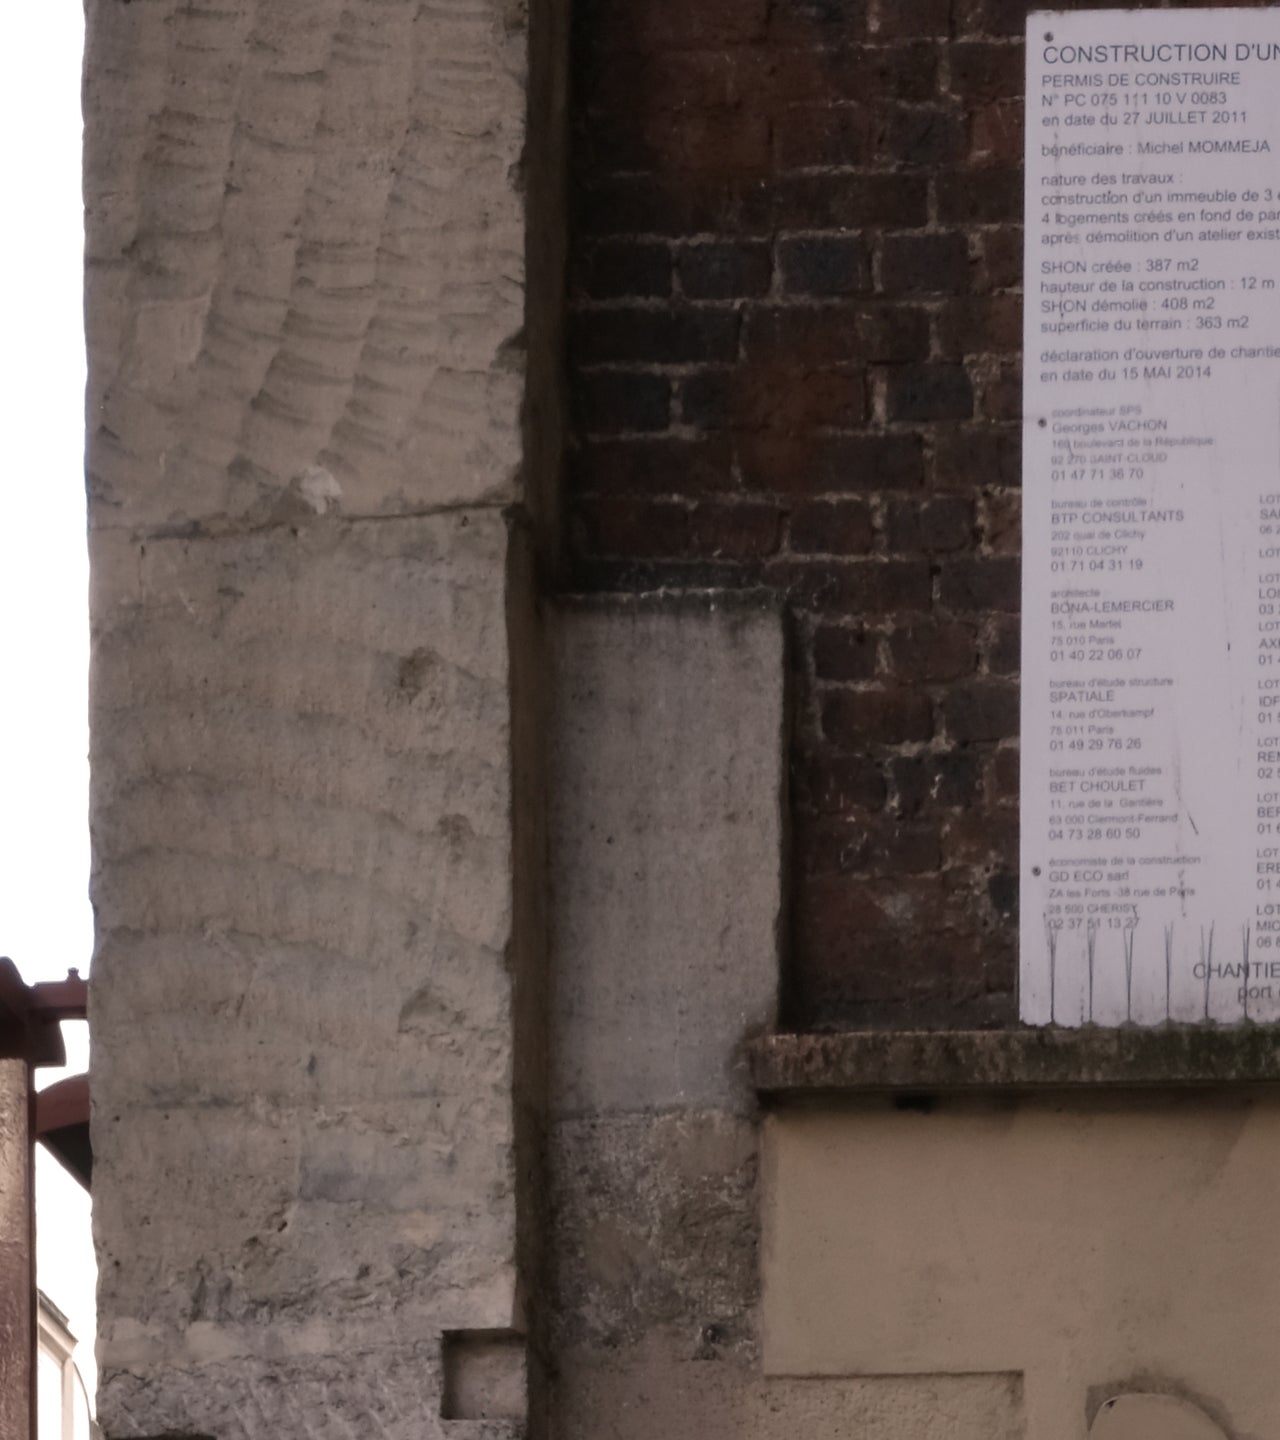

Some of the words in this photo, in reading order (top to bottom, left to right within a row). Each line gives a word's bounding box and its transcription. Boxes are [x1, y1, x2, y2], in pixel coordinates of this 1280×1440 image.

[1043, 44, 1227, 63] CONSTRUCTION
[1042, 74, 1103, 87] PERMIS
[1108, 73, 1130, 87] DE
[1135, 72, 1240, 86] CONSTRUIRE
[1064, 93, 1086, 107] PC
[1090, 93, 1118, 106] 075
[1124, 93, 1147, 106] 111
[1156, 92, 1171, 105] 10
[1176, 92, 1187, 104] V
[1191, 91, 1227, 105] 0083
[1042, 116, 1060, 127] en
[1064, 115, 1095, 126] date
[1100, 113, 1118, 126] du
[1123, 111, 1140, 125] 27
[1145, 111, 1206, 124] JUILLET
[1212, 110, 1246, 124] 2011
[1137, 142, 1183, 154] Michel
[1188, 140, 1270, 153] MOMMEJA
[1041, 175, 1087, 186] nature
[1091, 174, 1117, 185] des
[1041, 193, 1128, 205] construction
[1133, 191, 1162, 204] d'un
[1167, 192, 1237, 202] immeuble
[1241, 190, 1259, 202] de
[1264, 188, 1273, 202] 3
[1042, 213, 1050, 224] 4
[1055, 213, 1129, 225] logements
[1134, 212, 1173, 223] créés
[1177, 212, 1195, 222] en
[1200, 209, 1231, 222] fond
[1236, 210, 1254, 221] de
[1086, 231, 1159, 243] démolition
[1164, 230, 1194, 242] d'un
[1198, 230, 1242, 241] atelier
[1041, 261, 1087, 274] SHON
[1092, 262, 1132, 273] créée
[1146, 258, 1172, 272] 387
[1177, 258, 1199, 271] m2
[1040, 282, 1095, 293] hauteur
[1099, 281, 1117, 292] de
[1122, 280, 1134, 292] la
[1139, 280, 1226, 291] construction
[1241, 276, 1257, 290] 12
[1261, 279, 1275, 289] m
[1041, 299, 1087, 313] SHON
[1091, 299, 1148, 312] démolie
[1161, 297, 1188, 310] 408
[1193, 297, 1215, 310] m2
[1041, 320, 1109, 334] superficie
[1113, 320, 1132, 331] du
[1196, 316, 1222, 329] 363
[1227, 316, 1249, 329] m2
[1040, 350, 1119, 362] déclaration
[1123, 349, 1203, 360] d'ouverture
[1208, 348, 1226, 359] de
[1040, 371, 1058, 382] en
[1062, 370, 1094, 382] date
[1098, 369, 1116, 381] du
[1123, 366, 1138, 380] 15
[1143, 366, 1171, 379] MAI
[1176, 365, 1211, 379] 2014
[1052, 423, 1104, 434] Georges
[1109, 419, 1167, 431] VACHON
[1051, 512, 1078, 524] BTP
[1082, 510, 1184, 523] CONSULTANTS
[1238, 985, 1270, 1003] port
